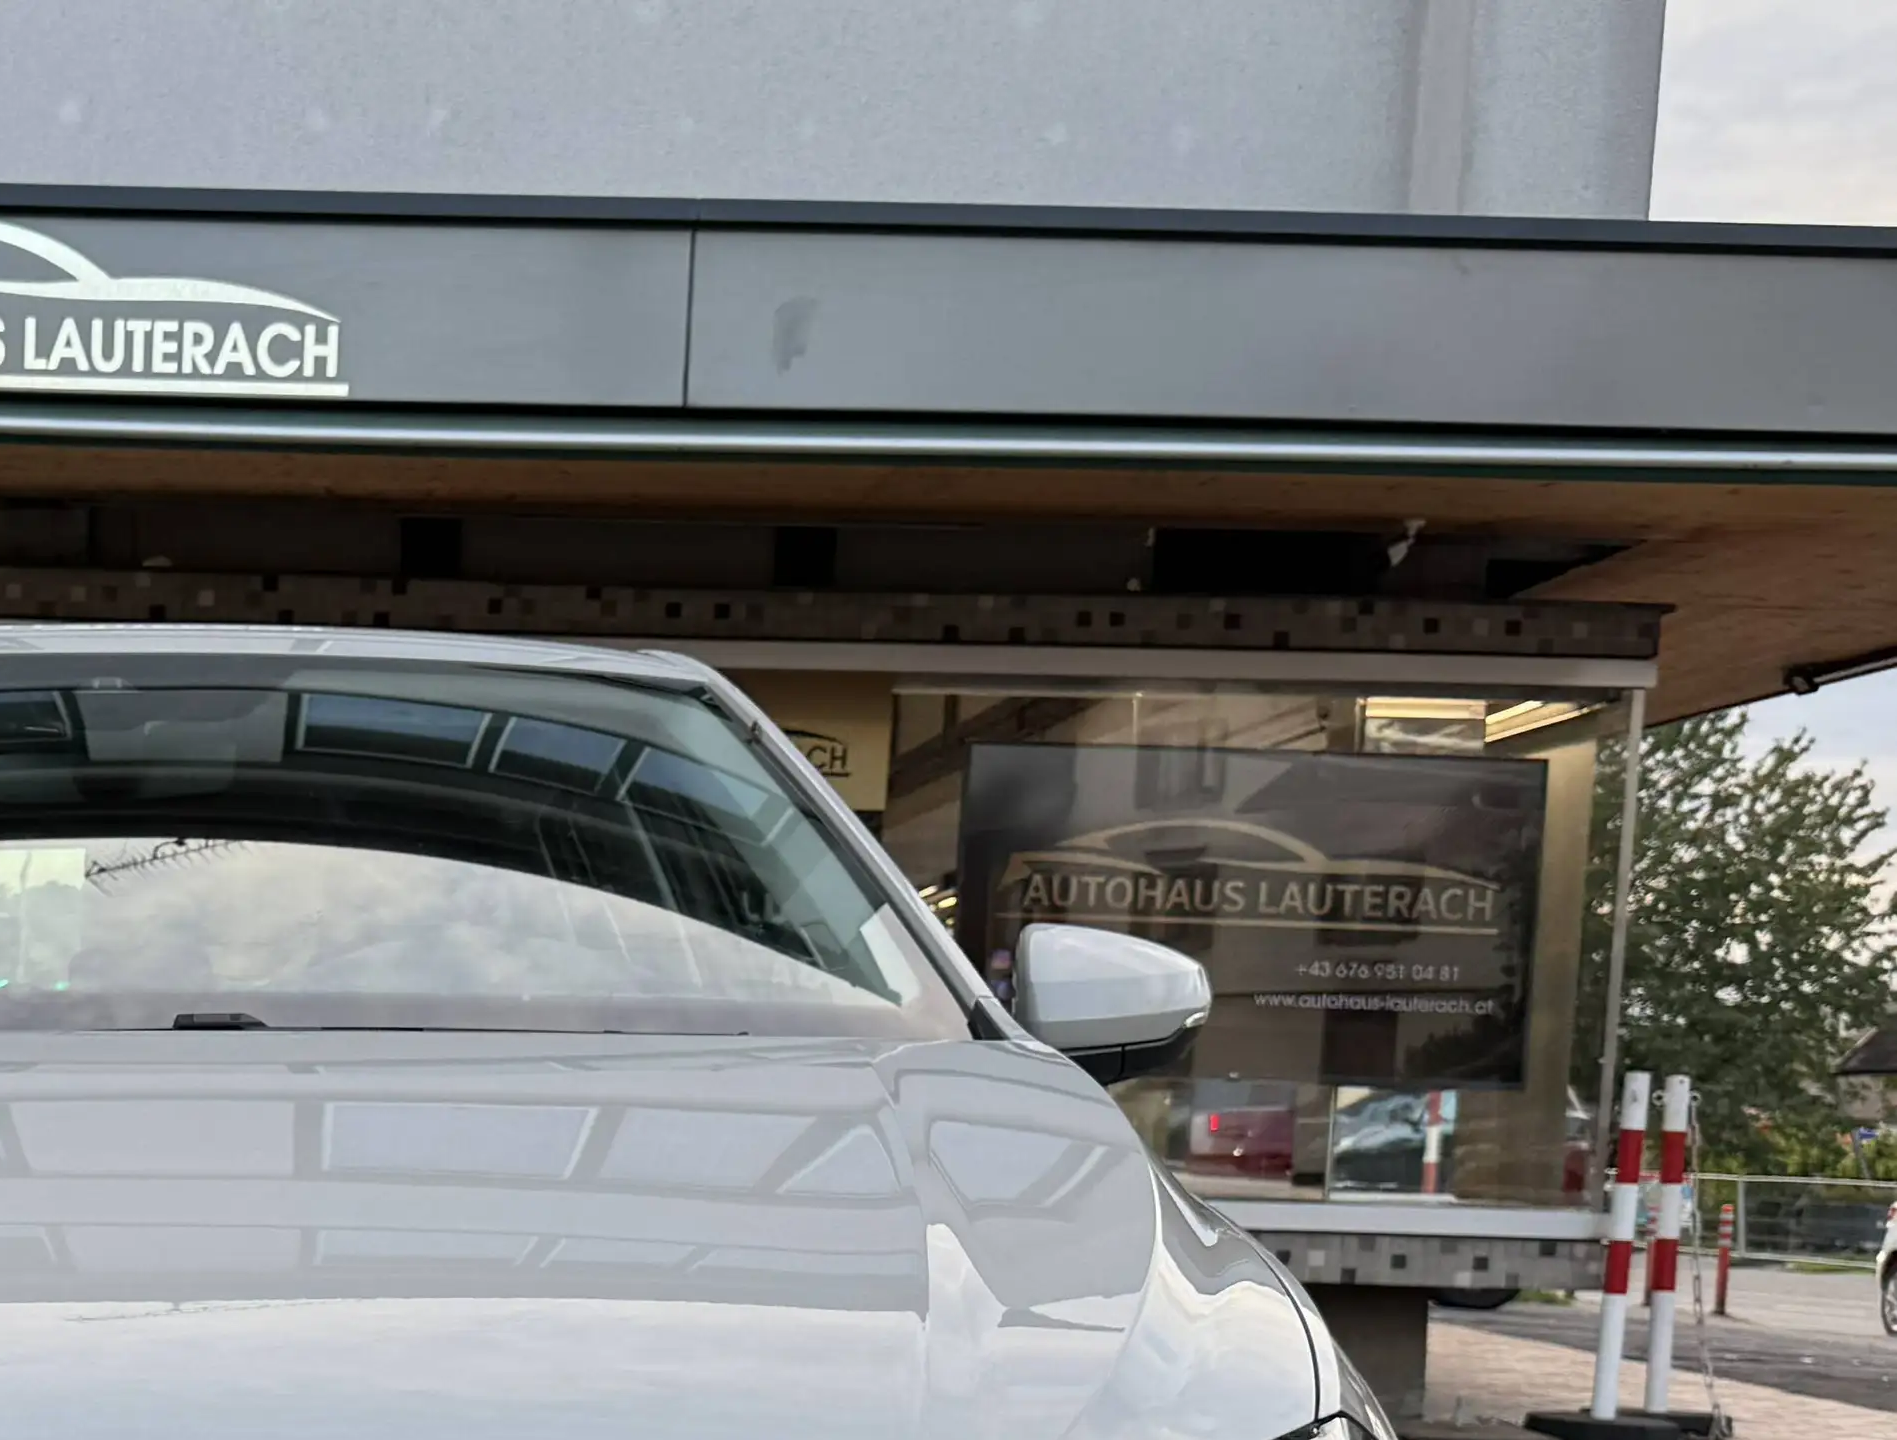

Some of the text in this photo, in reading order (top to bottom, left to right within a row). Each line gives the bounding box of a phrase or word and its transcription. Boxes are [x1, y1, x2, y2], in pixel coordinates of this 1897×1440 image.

[23, 316, 340, 378] LAUTERACH
[1023, 873, 1495, 921] AUTOHAUS LAUTERACH
[1296, 960, 1331, 977] +43
[1335, 962, 1371, 979] 676
[1253, 992, 1495, 1016] www.autohaus-lauterach.at
